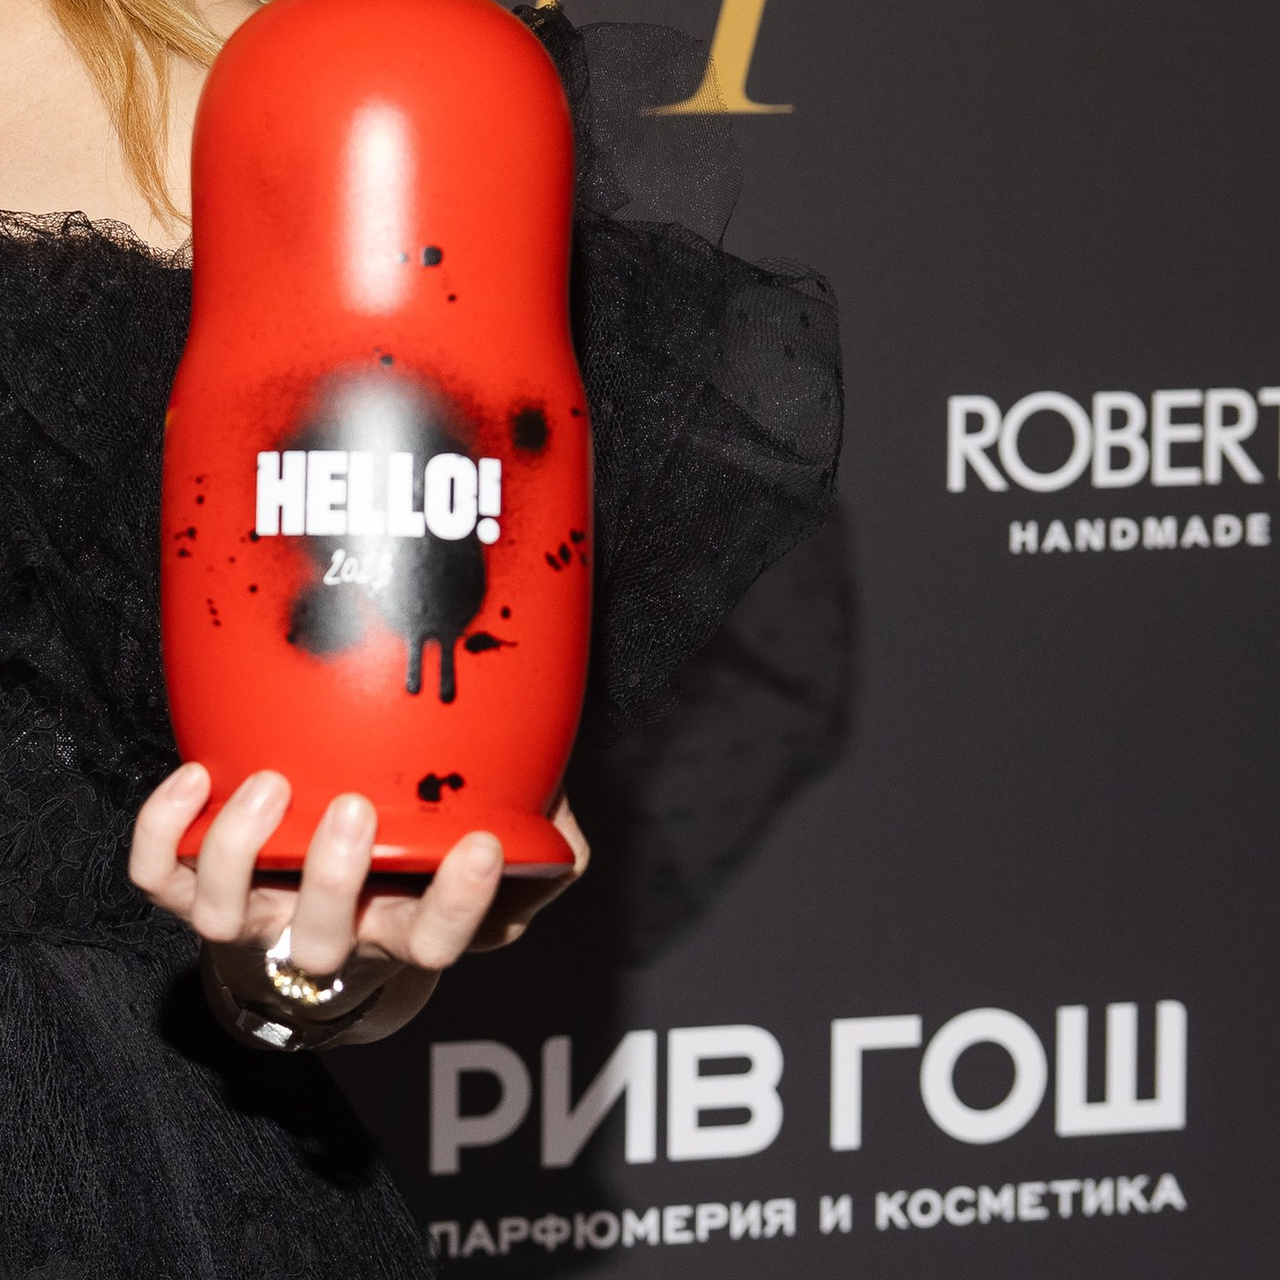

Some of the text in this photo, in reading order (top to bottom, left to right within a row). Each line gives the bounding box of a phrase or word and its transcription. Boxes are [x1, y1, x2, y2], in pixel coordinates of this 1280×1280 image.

[255, 450, 501, 545] HELLO!
[1008, 512, 1272, 554] HANDMADE
[428, 999, 1188, 1176] РИВ ГОШ
[429, 1173, 1187, 1258] ПАРФЮМЕРИЯ И КОСМЕТИКА
